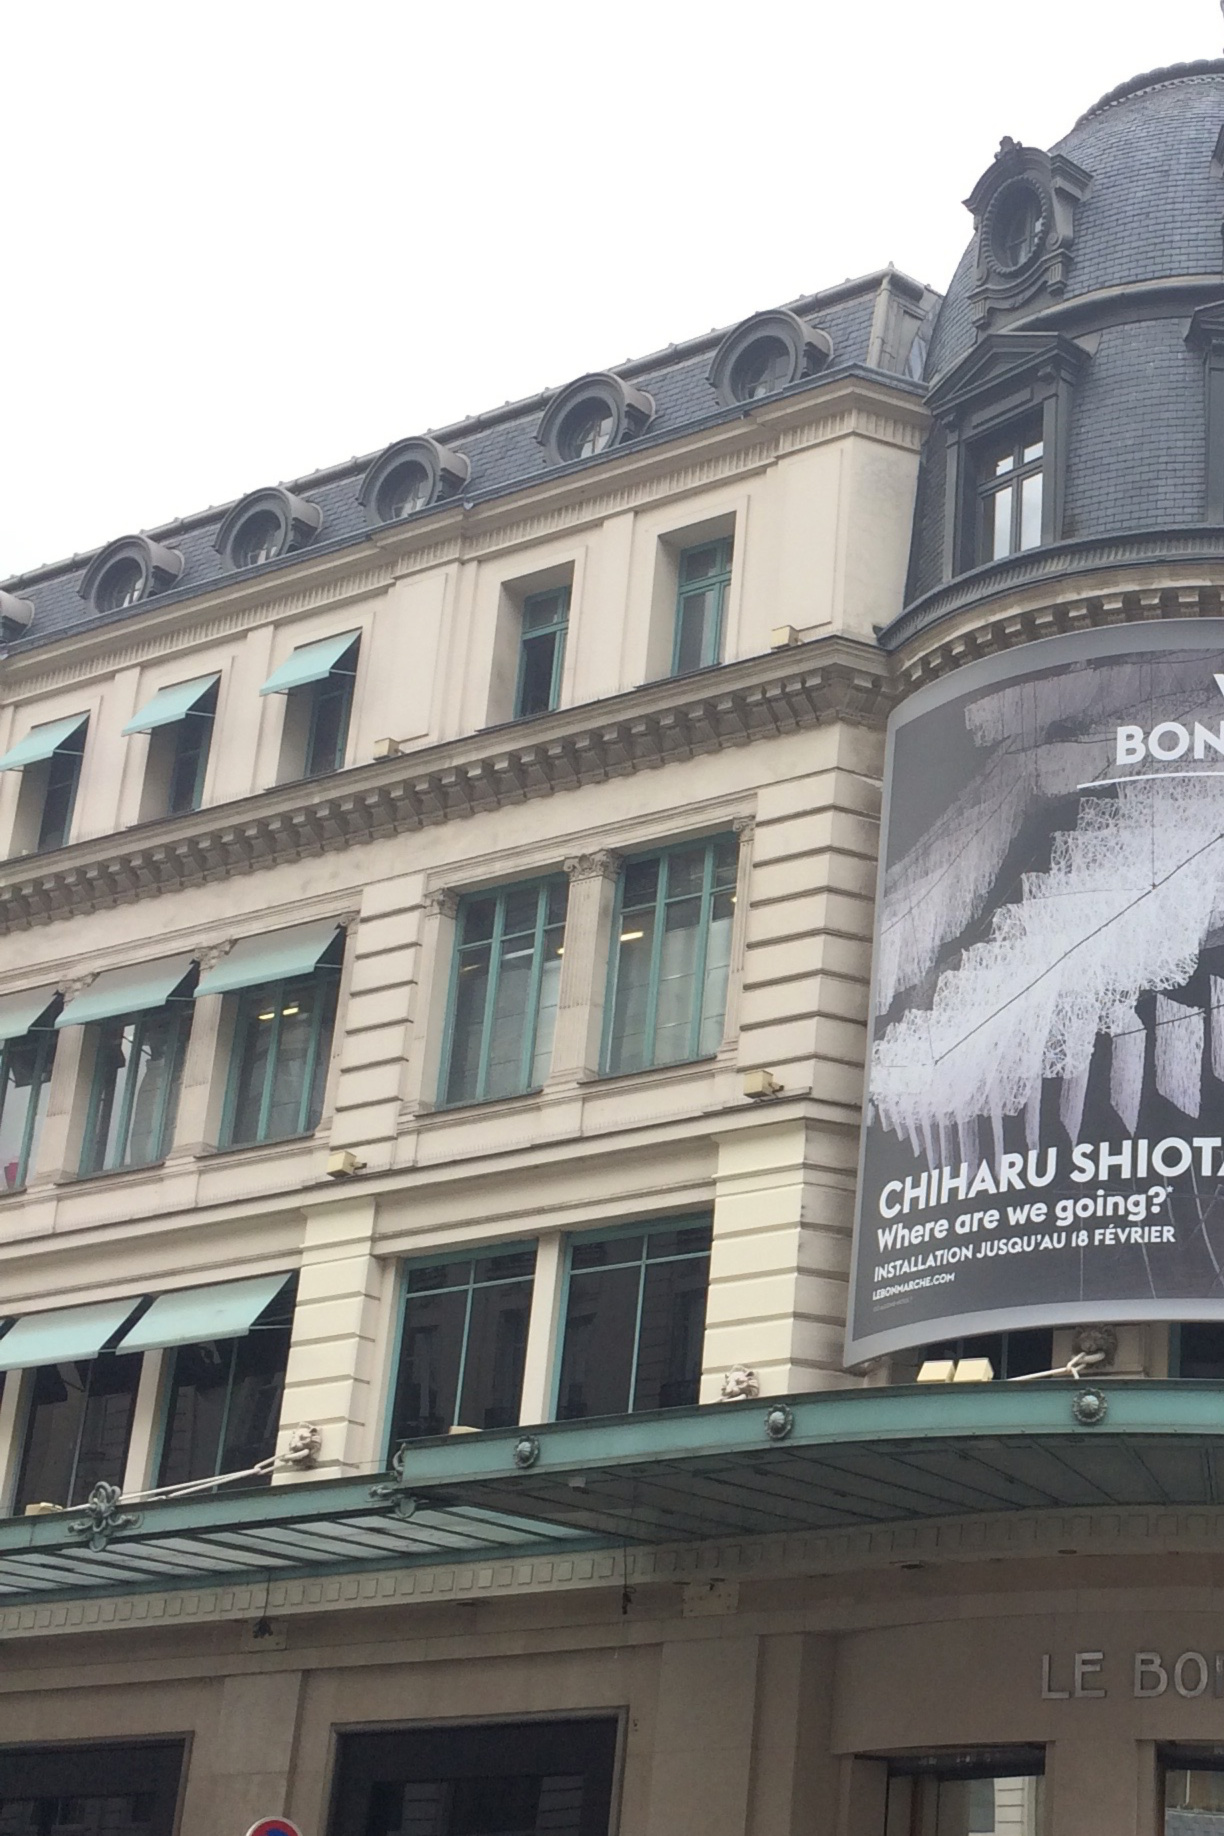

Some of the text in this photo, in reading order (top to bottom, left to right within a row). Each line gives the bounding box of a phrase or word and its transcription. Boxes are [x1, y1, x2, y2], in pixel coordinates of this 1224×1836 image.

[878, 1146, 1057, 1219] CHIHARU
[877, 1218, 948, 1253] Where
[955, 1208, 1000, 1236] are
[1007, 1201, 1047, 1225] we
[873, 1225, 1176, 1282] INSTALLATION JUSQU'AU 18 FÉVRIER
[872, 1272, 956, 1301] LEBONMARCHE.COM
[1041, 1651, 1106, 1700] LE
